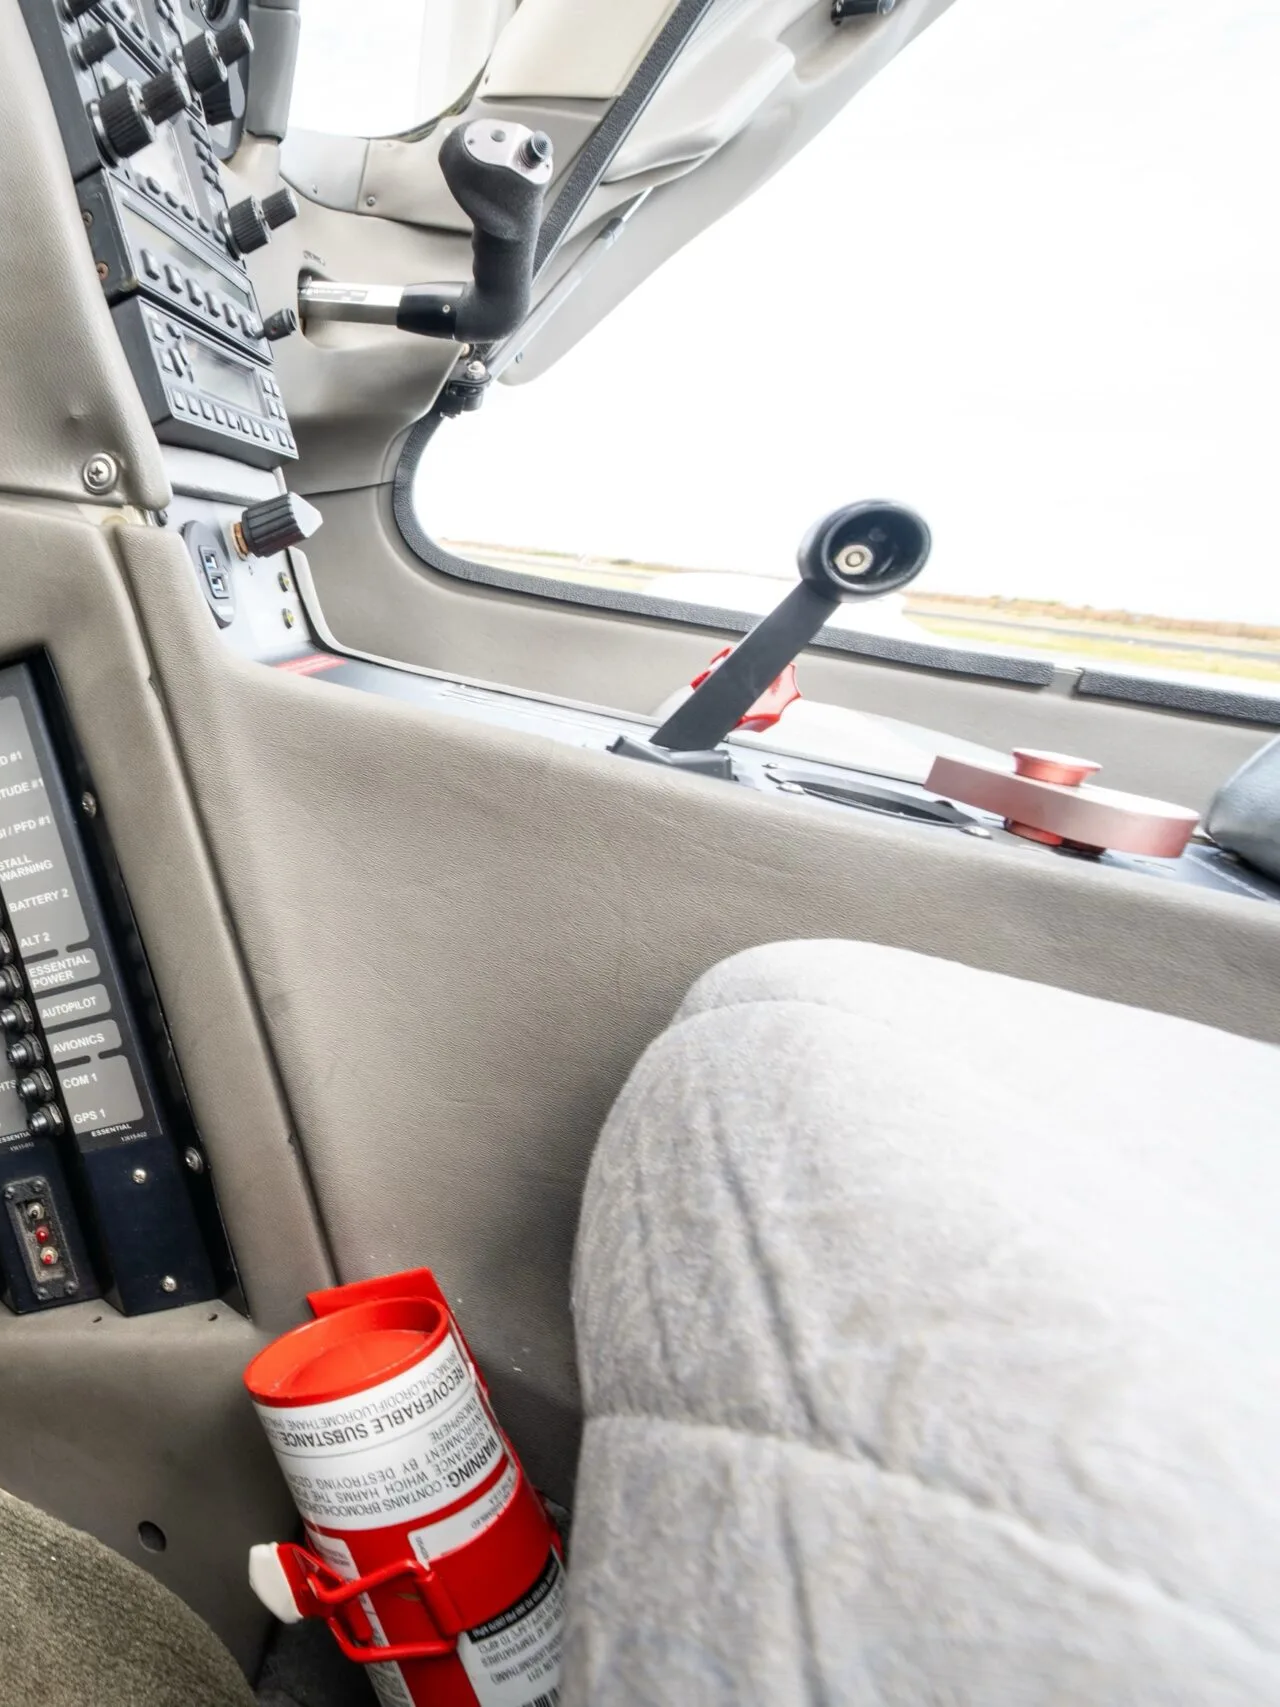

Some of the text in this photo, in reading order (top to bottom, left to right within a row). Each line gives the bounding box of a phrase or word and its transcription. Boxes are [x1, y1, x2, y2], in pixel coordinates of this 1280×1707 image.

[10, 751, 23, 763] #1
[31, 777, 44, 789] #1
[13, 818, 37, 836] PFD
[38, 815, 51, 826] #1
[0, 860, 54, 883] WARNING
[8, 888, 70, 914] BATTERY 2
[19, 932, 51, 949] ALT 2
[28, 953, 92, 979] ESSENTIAL
[32, 970, 75, 989] POWER
[41, 995, 98, 1019] AUTOPILOT
[52, 1033, 106, 1055] AVIONICS
[62, 1076, 90, 1090] COM
[73, 1110, 98, 1125] GPS
[91, 1122, 132, 1138] ESSENTIAL
[373, 1363, 465, 1435] RECOVERABLE
[435, 1429, 487, 1477] SUBSTANCE
[442, 1434, 498, 1489] WARNING:
[402, 1458, 419, 1473] BY
[315, 1467, 397, 1491] DESTROYING
[384, 1470, 429, 1498] WHICH
[310, 1492, 332, 1504] THE
[335, 1487, 380, 1505] HARMS
[383, 1477, 443, 1511] CONTAINS
